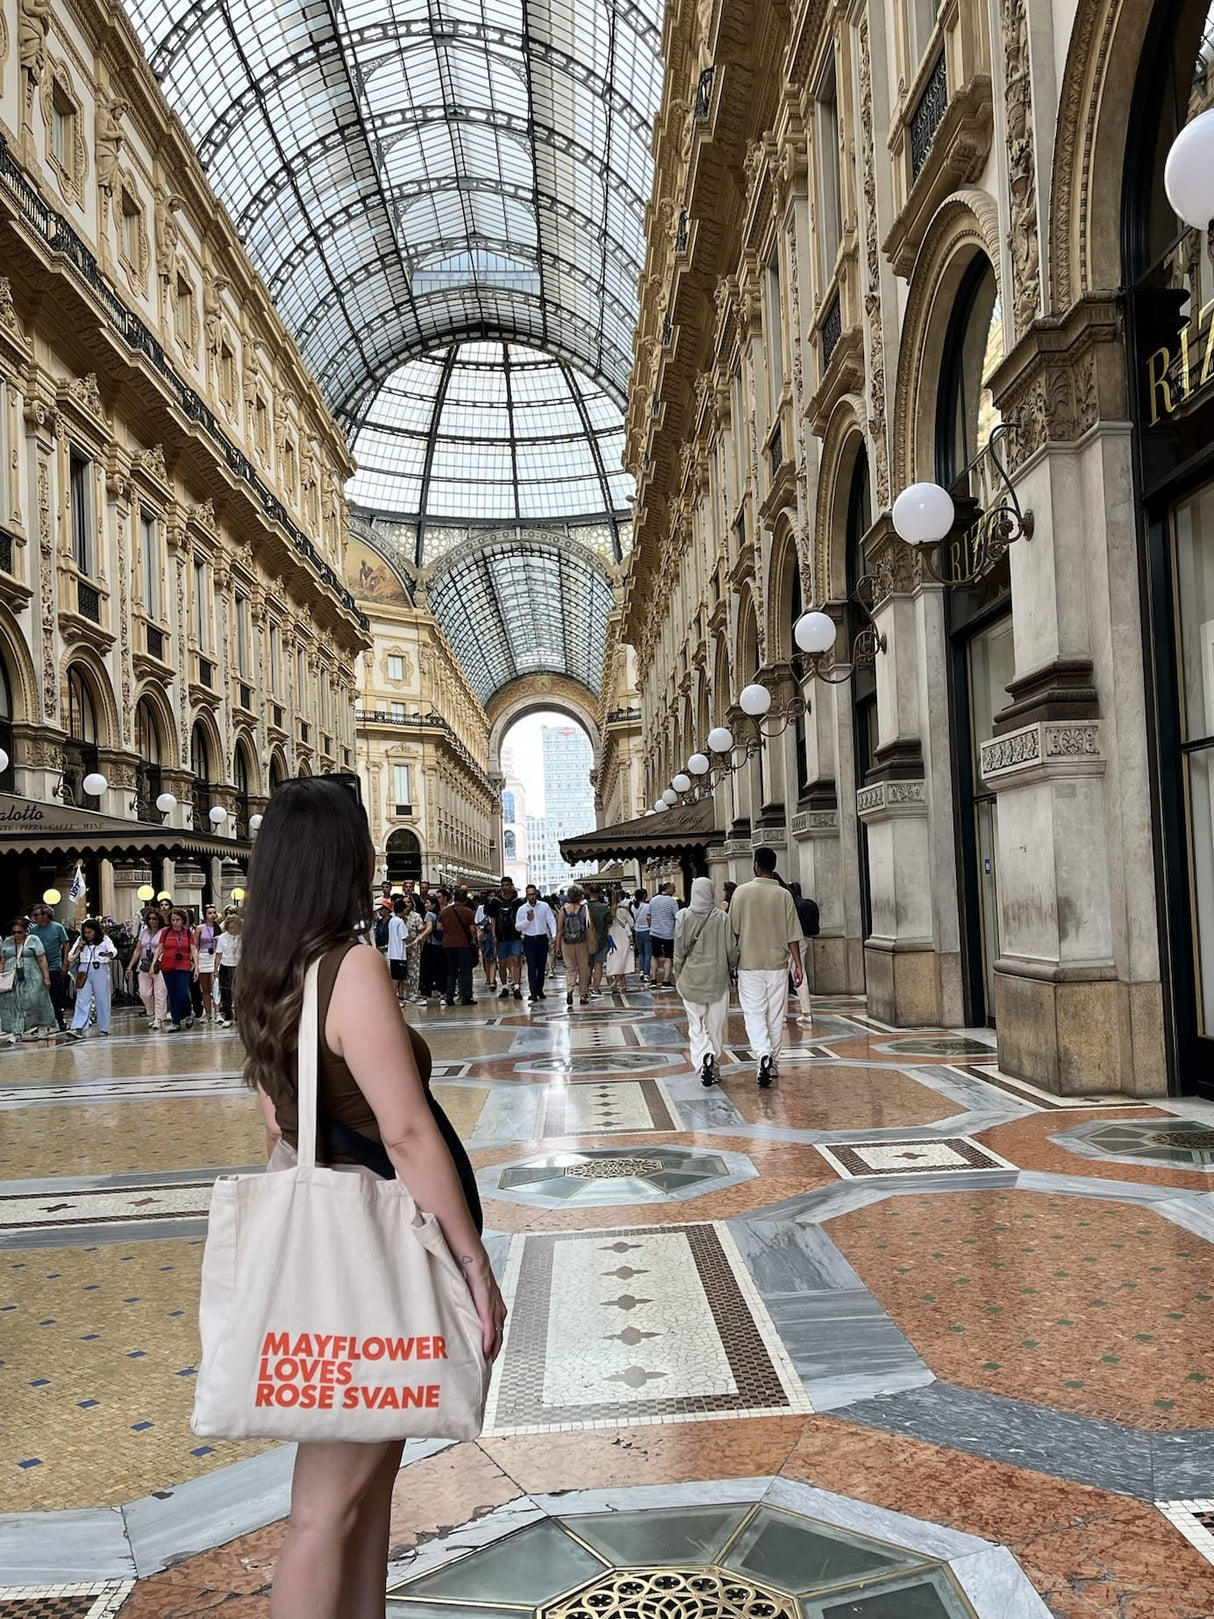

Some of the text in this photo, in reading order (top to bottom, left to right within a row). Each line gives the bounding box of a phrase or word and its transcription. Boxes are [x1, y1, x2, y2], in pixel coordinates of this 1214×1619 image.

[261, 1332, 449, 1361] MAYFLOWER
[258, 1357, 353, 1386] LOVES
[254, 1383, 441, 1409] ROSE SVANE
